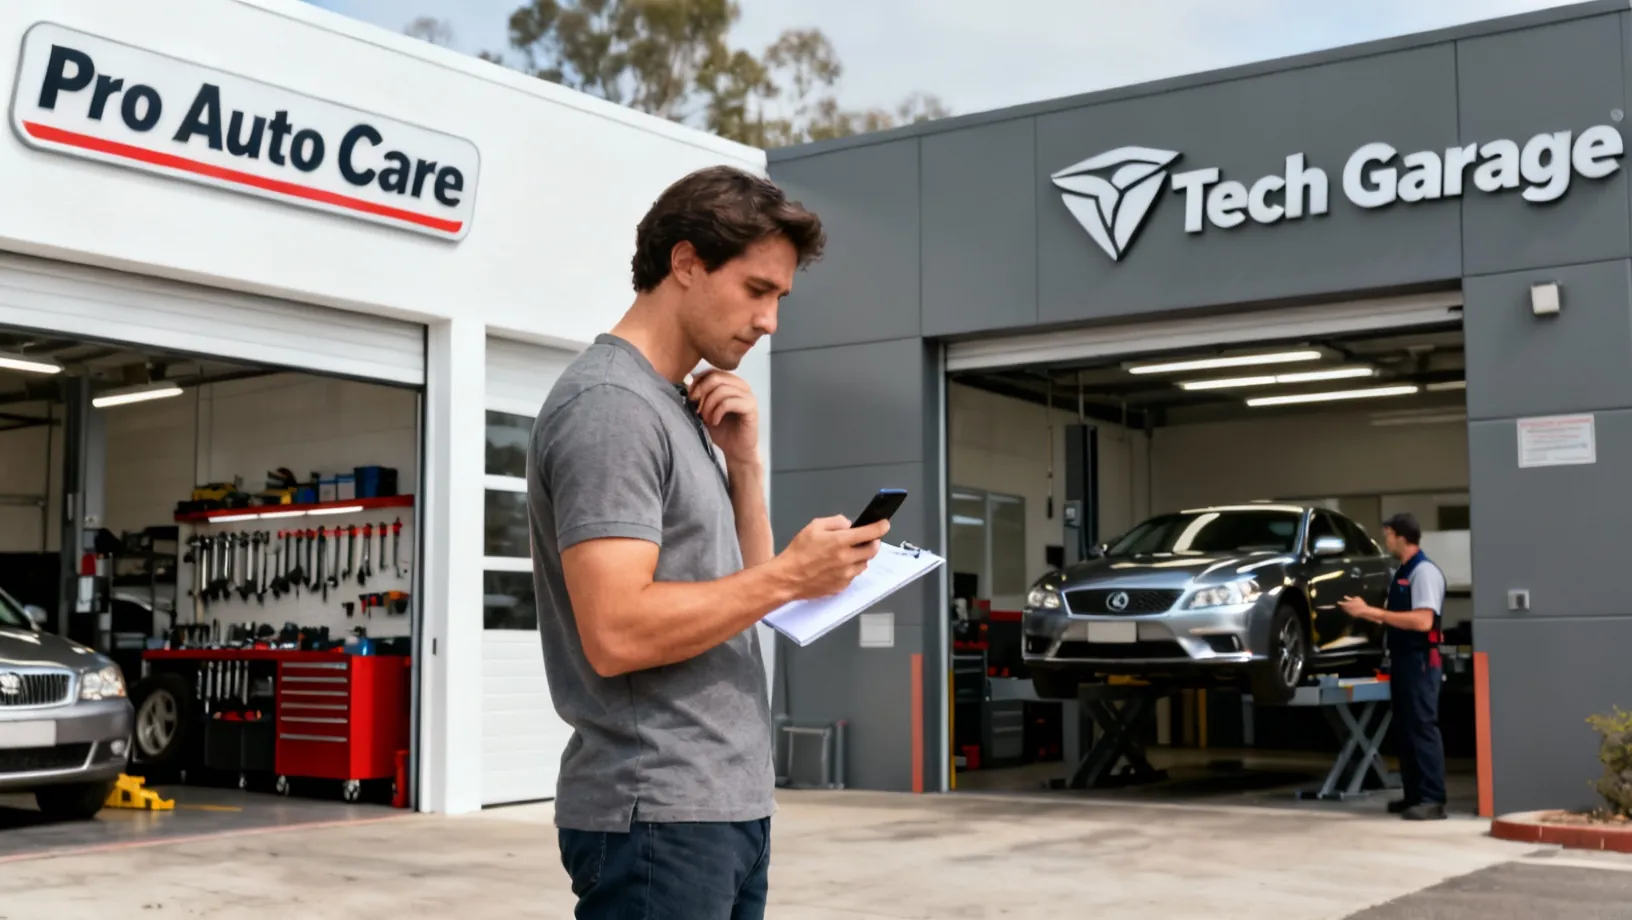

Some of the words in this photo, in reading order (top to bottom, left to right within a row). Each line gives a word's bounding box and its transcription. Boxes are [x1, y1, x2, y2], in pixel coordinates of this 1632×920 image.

[37, 44, 162, 132] Pro
[172, 83, 325, 172] Auto
[338, 124, 464, 207] Care
[1171, 152, 1329, 233] Tech
[1342, 124, 1624, 208] Garage
